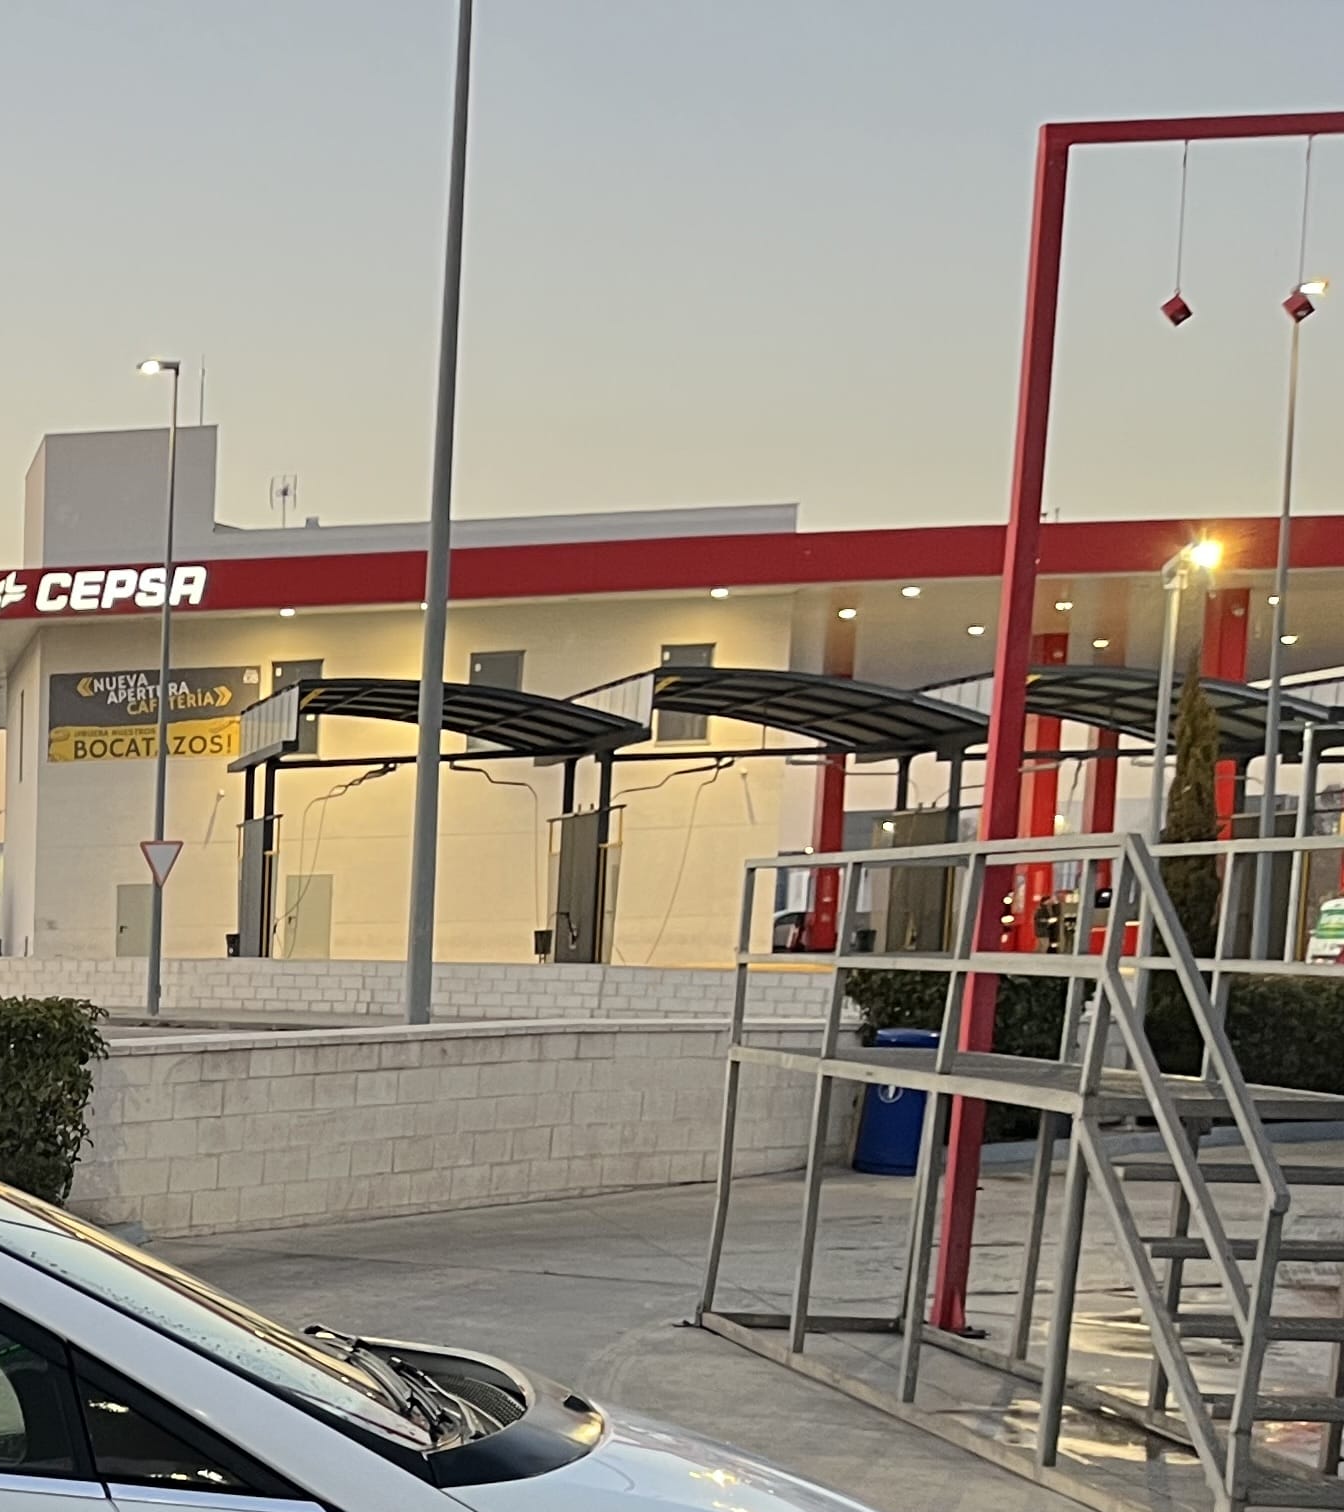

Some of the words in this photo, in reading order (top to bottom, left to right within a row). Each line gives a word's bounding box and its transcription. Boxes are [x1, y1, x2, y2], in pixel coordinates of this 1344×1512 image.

[35, 566, 207, 612] CEPSA
[93, 673, 149, 692] NUEVA
[127, 688, 215, 715] CAFTERÍA
